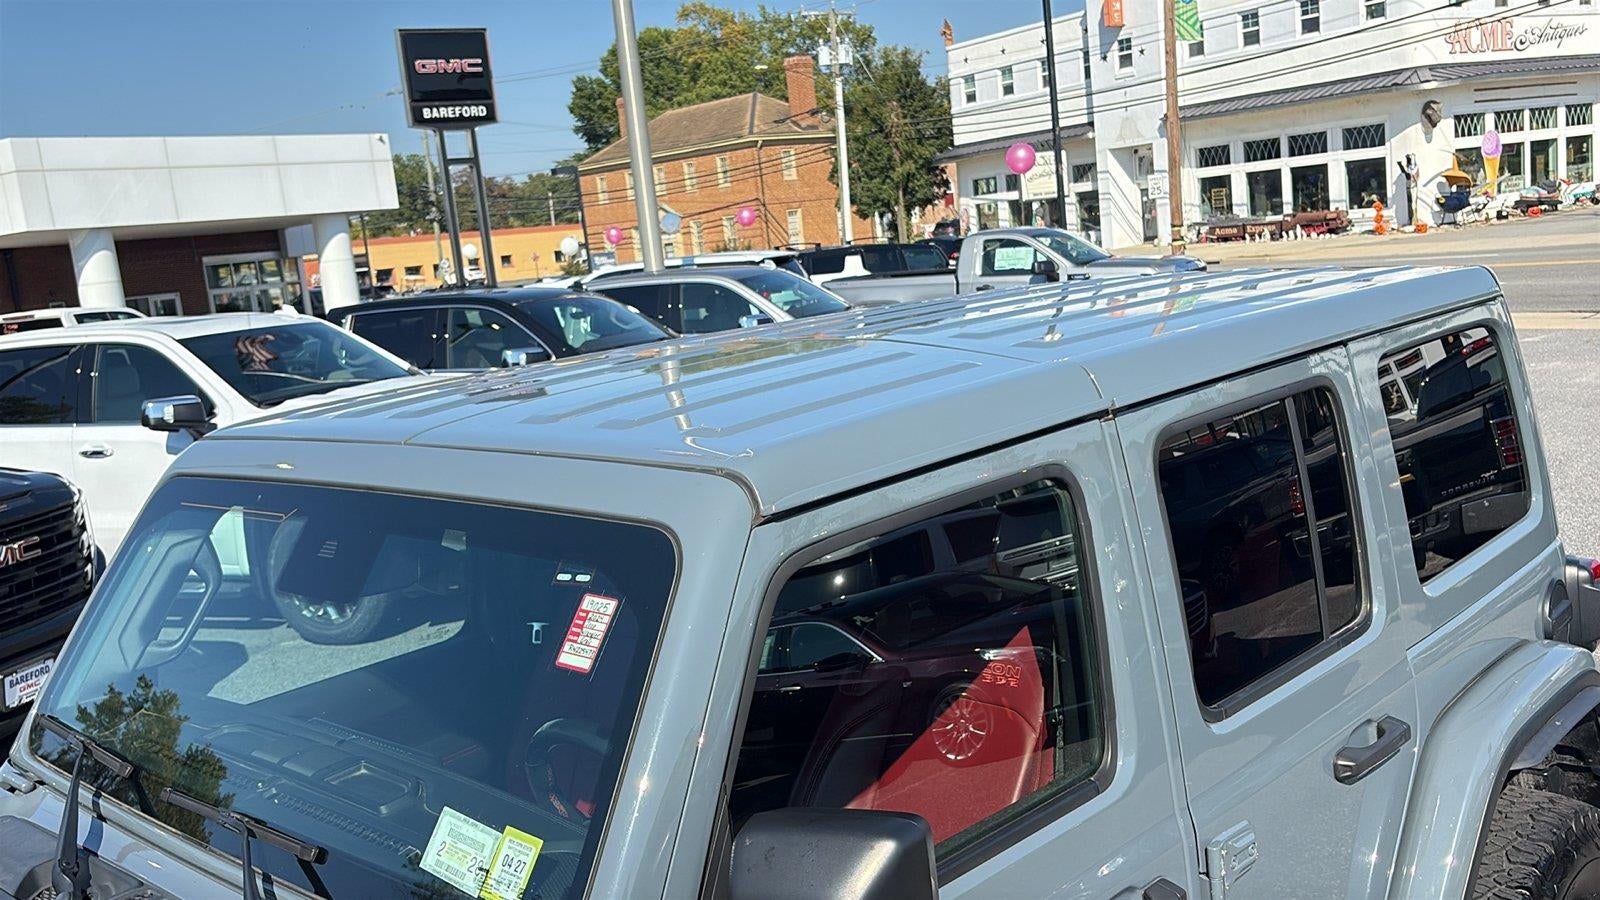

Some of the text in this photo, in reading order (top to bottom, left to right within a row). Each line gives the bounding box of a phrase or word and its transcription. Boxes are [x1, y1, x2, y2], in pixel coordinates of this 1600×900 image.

[1444, 18, 1514, 55] ACME
[415, 58, 483, 74] GMC
[422, 105, 487, 119] BAREFORD
[1150, 185, 1162, 195] 25
[9, 664, 50, 689] BAREFORD
[19, 679, 42, 695] GMC
